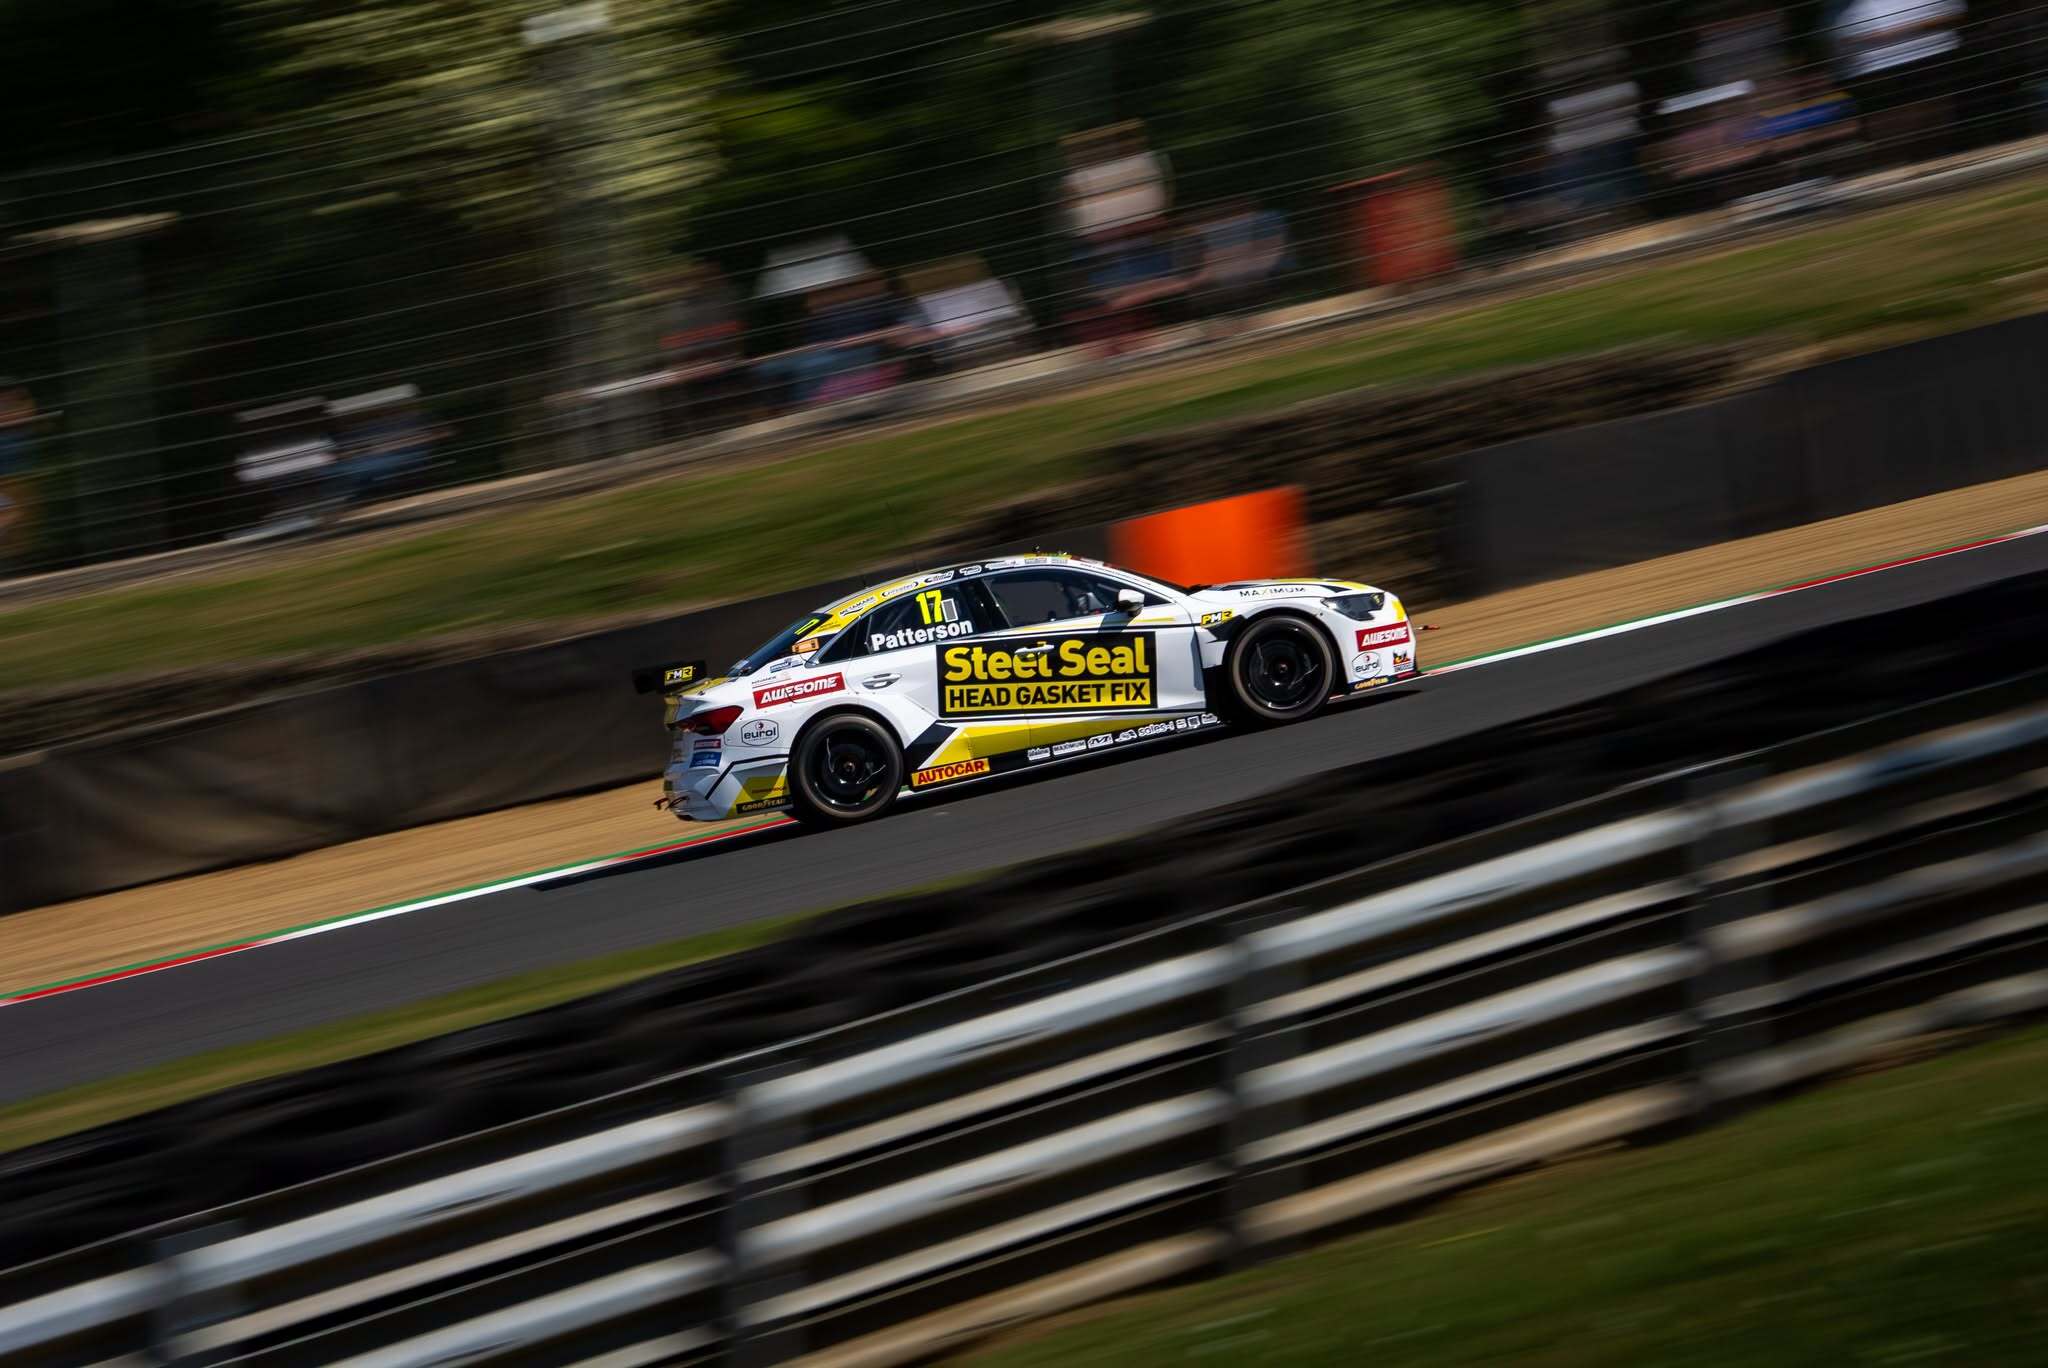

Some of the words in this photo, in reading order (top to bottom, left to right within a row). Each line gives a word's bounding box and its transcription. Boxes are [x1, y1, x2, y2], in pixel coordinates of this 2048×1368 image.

[1240, 587, 1306, 597] MAXIMUM
[916, 590, 944, 625] 17
[871, 620, 973, 652] Patterson
[1361, 626, 1408, 647] AWESOME
[944, 641, 1052, 682] Steel
[1059, 637, 1150, 677] Seal
[760, 676, 838, 705] AWESOME
[949, 686, 1010, 708] HEAD
[1016, 683, 1106, 706] GASKET
[1111, 682, 1147, 702] FIX
[743, 727, 777, 740] eurol
[917, 760, 985, 785] AUTOCAR
[742, 799, 786, 811] GOODYEAR
